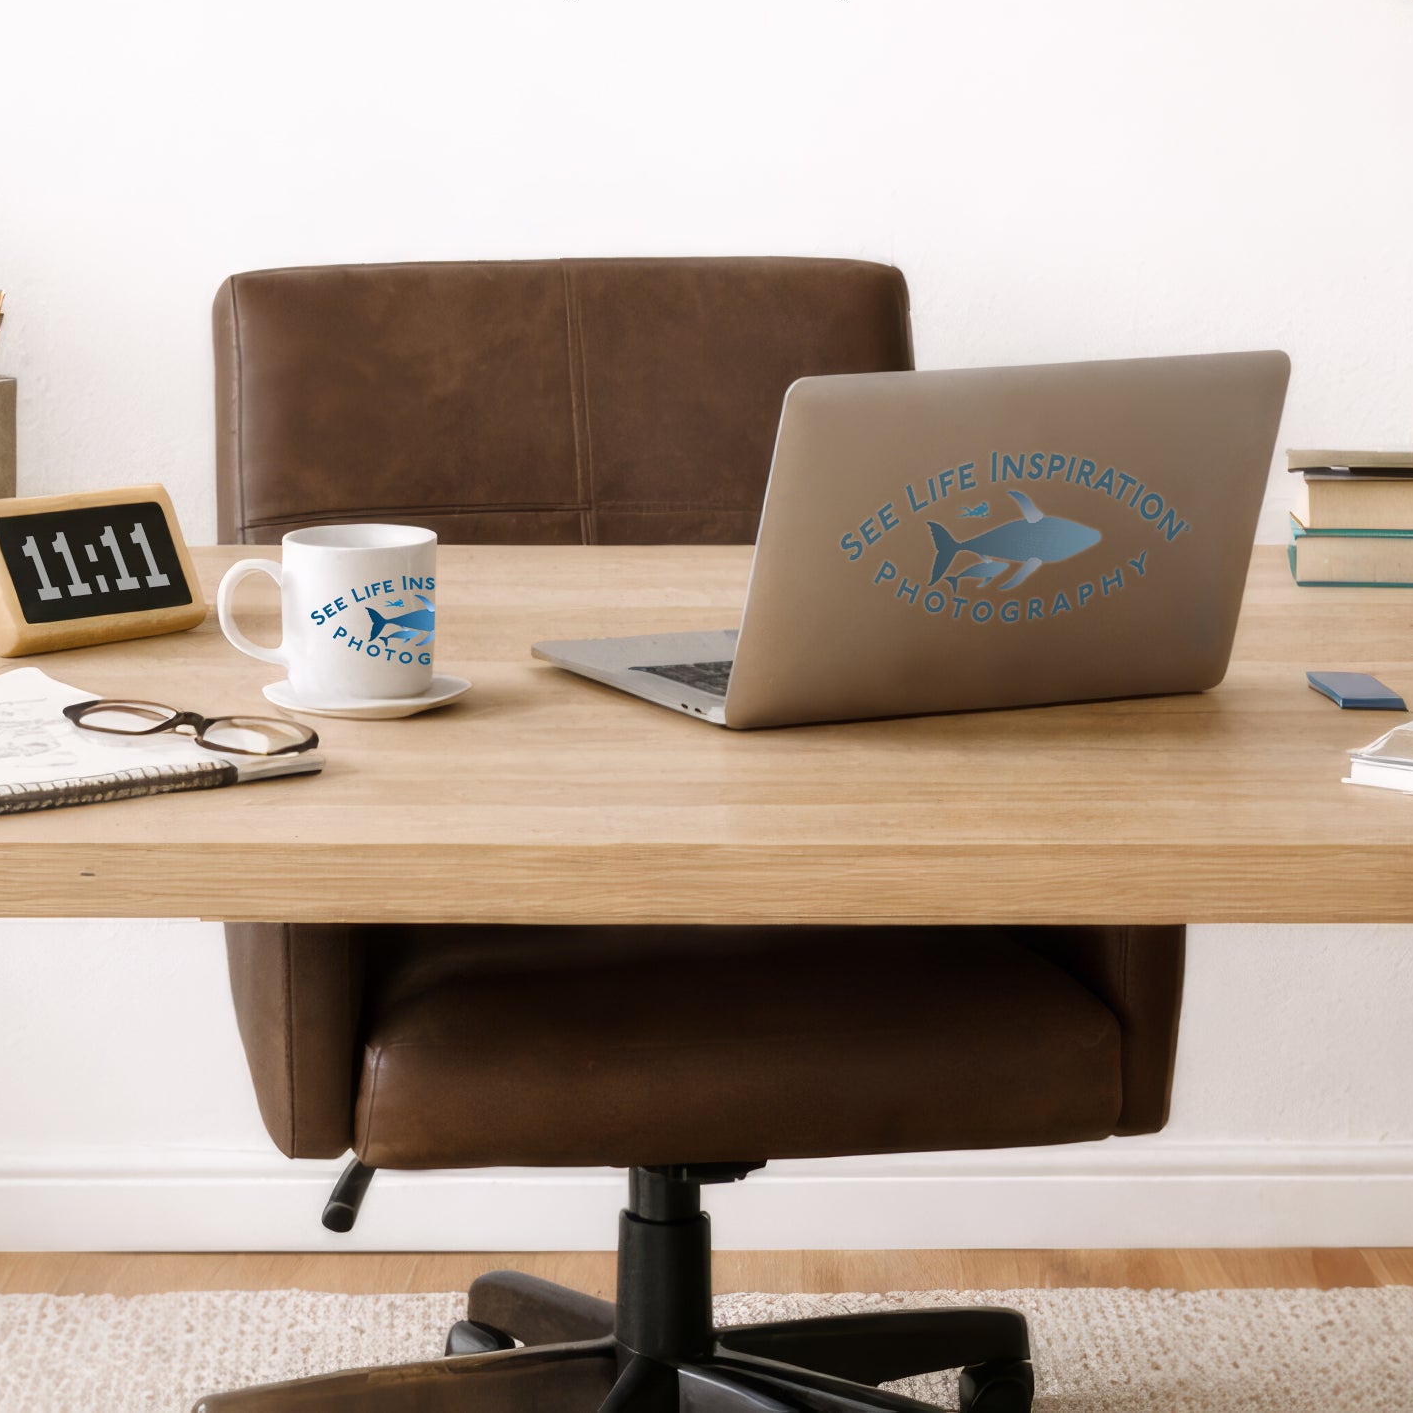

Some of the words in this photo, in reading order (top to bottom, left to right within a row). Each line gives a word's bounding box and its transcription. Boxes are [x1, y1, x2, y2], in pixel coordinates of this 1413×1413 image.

[840, 502, 900, 561] SEE
[906, 461, 977, 512] LIFE
[990, 451, 1186, 541] INSPIRATION
[21, 522, 171, 601] 11:11
[874, 551, 1147, 623] PHOTOGRAPHY
[310, 596, 348, 626] SEE
[350, 579, 395, 603] LIFE
[332, 625, 431, 666] PHOTOG
